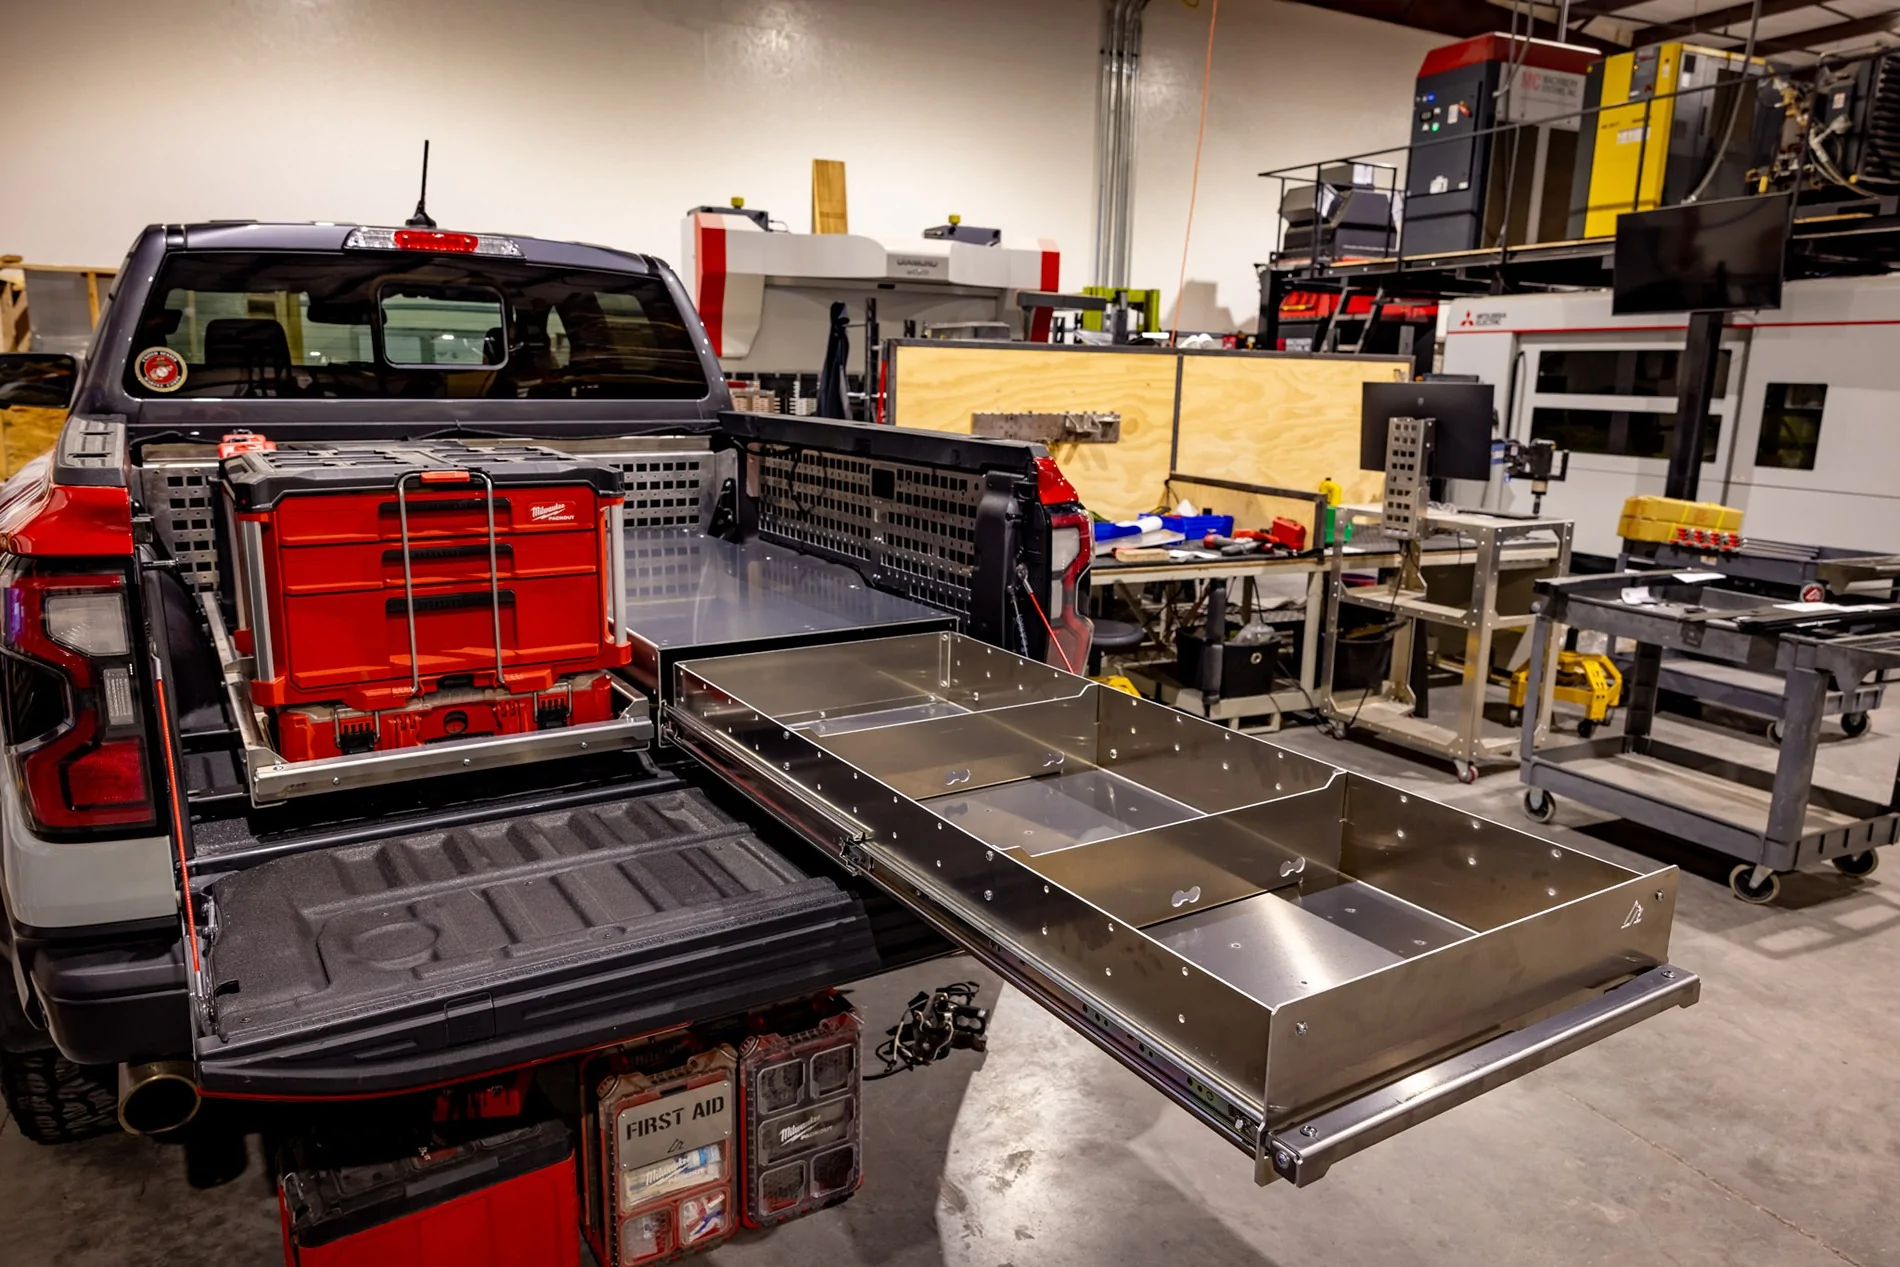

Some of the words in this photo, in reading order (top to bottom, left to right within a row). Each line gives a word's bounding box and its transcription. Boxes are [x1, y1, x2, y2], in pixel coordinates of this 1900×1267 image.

[530, 502, 566, 519] Milwaukee
[547, 514, 575, 522] PACKOUT
[626, 1107, 684, 1141] FIRST
[692, 1096, 724, 1121] AID
[778, 1113, 821, 1143] Milwaukee
[800, 1125, 833, 1141] PACKOUT
[645, 1156, 689, 1187] Milwaukee
